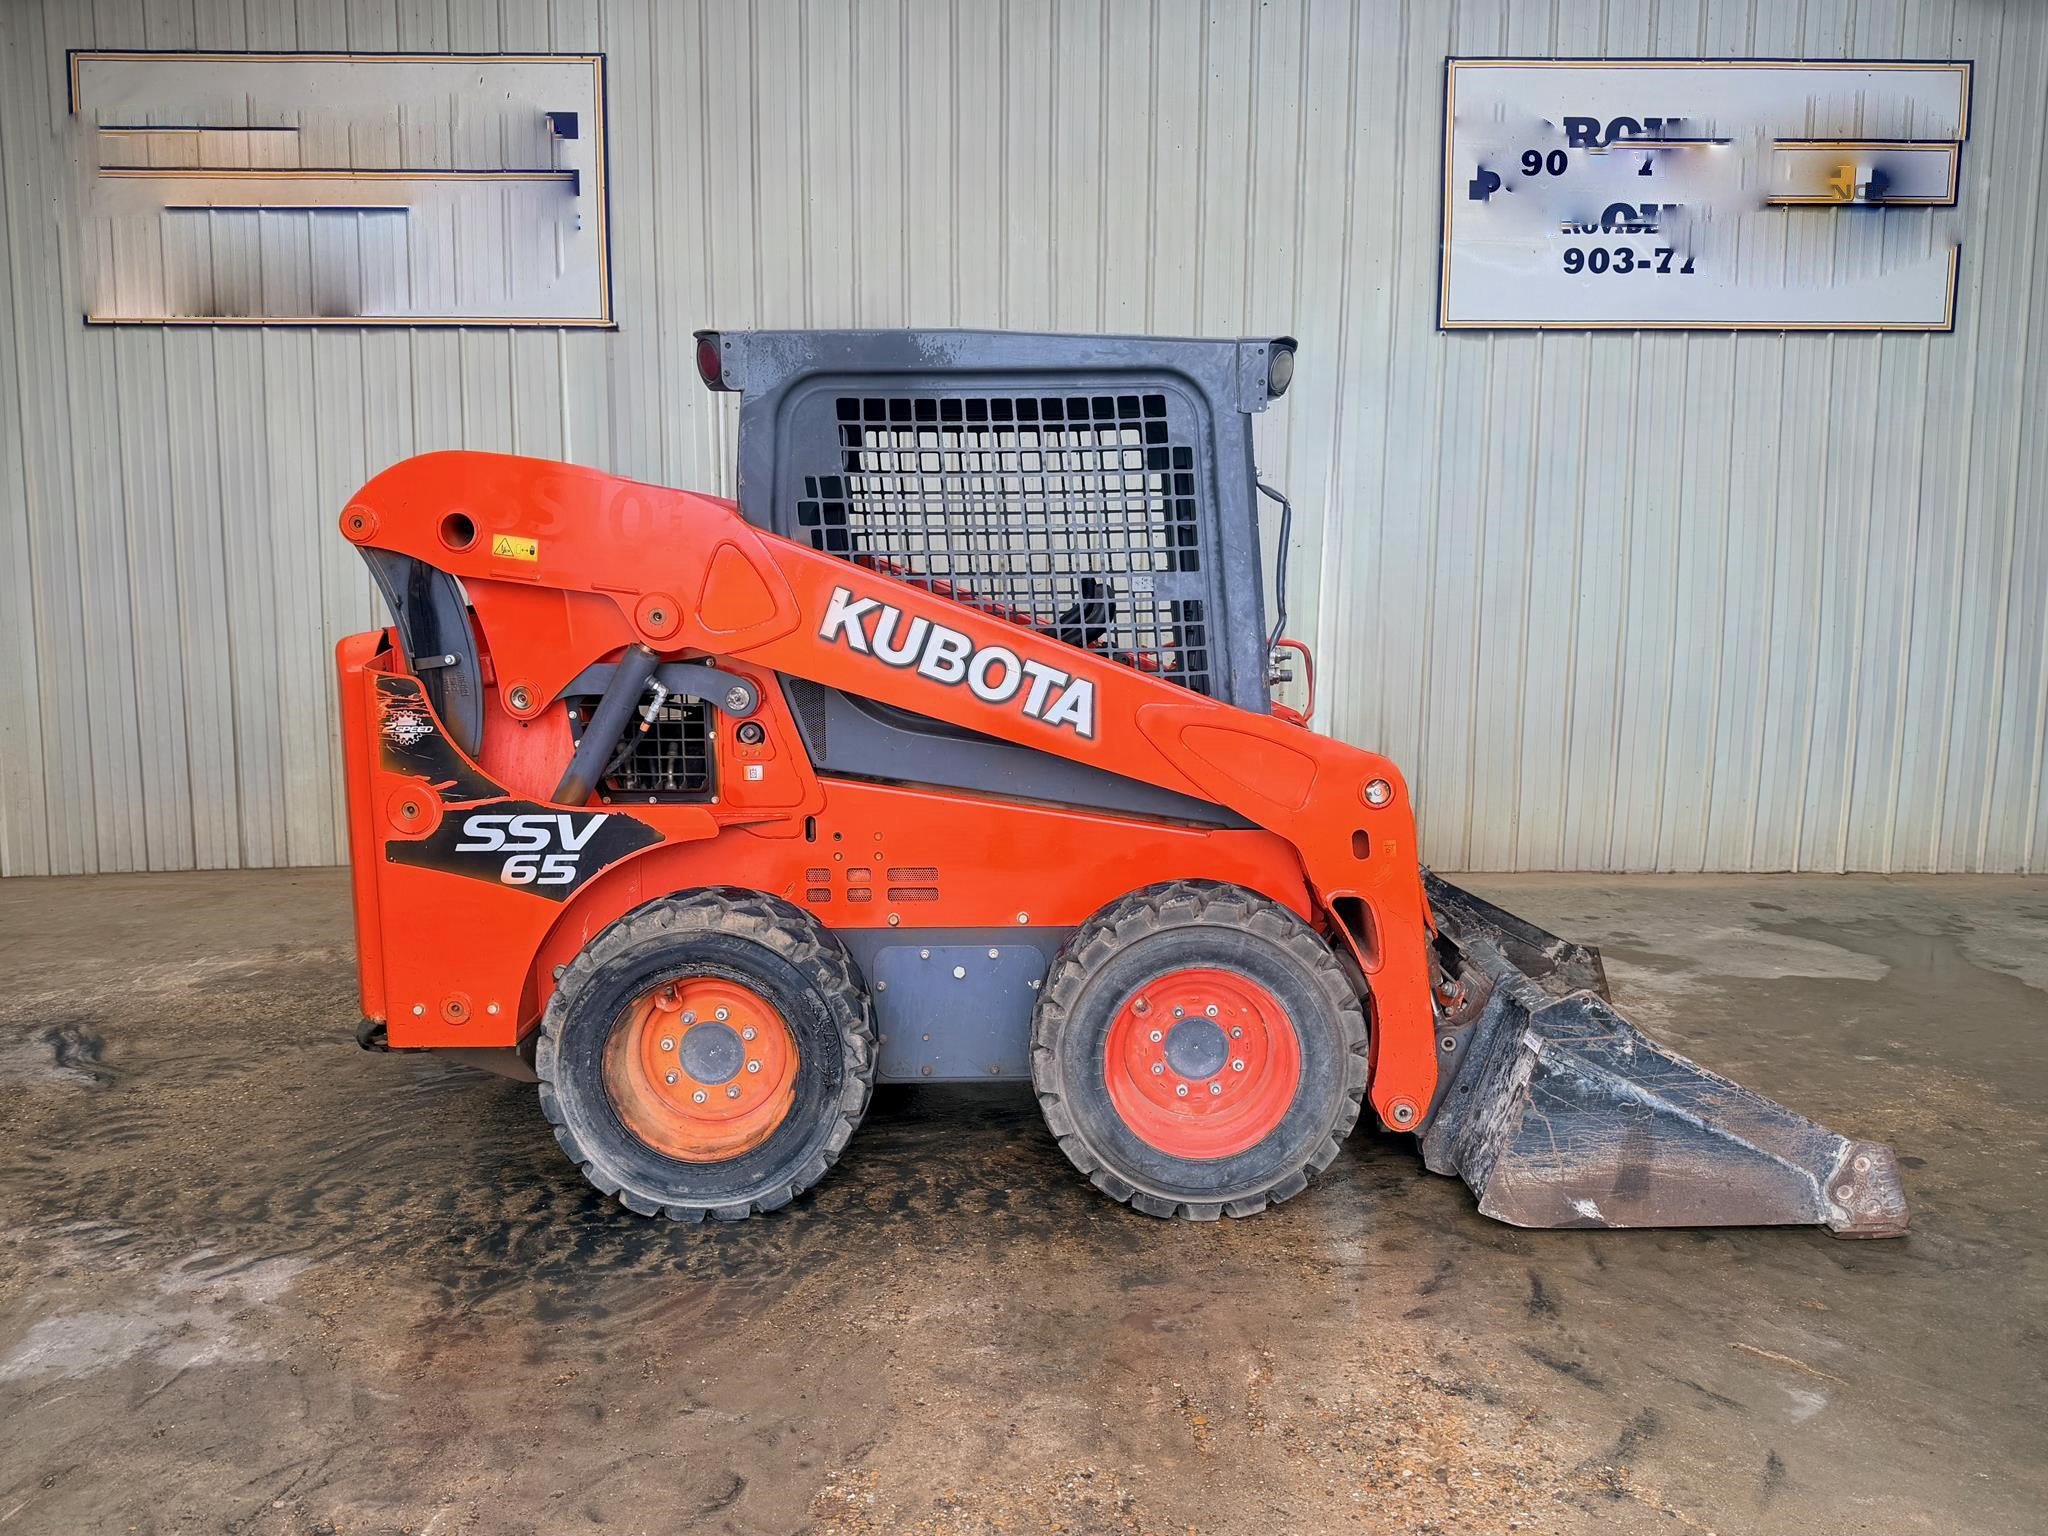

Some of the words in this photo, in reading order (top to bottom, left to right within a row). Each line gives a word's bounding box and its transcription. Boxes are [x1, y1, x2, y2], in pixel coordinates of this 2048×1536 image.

[819, 585, 1094, 739] KUBOTA
[455, 814, 609, 852] SSV
[501, 854, 580, 885] 65
